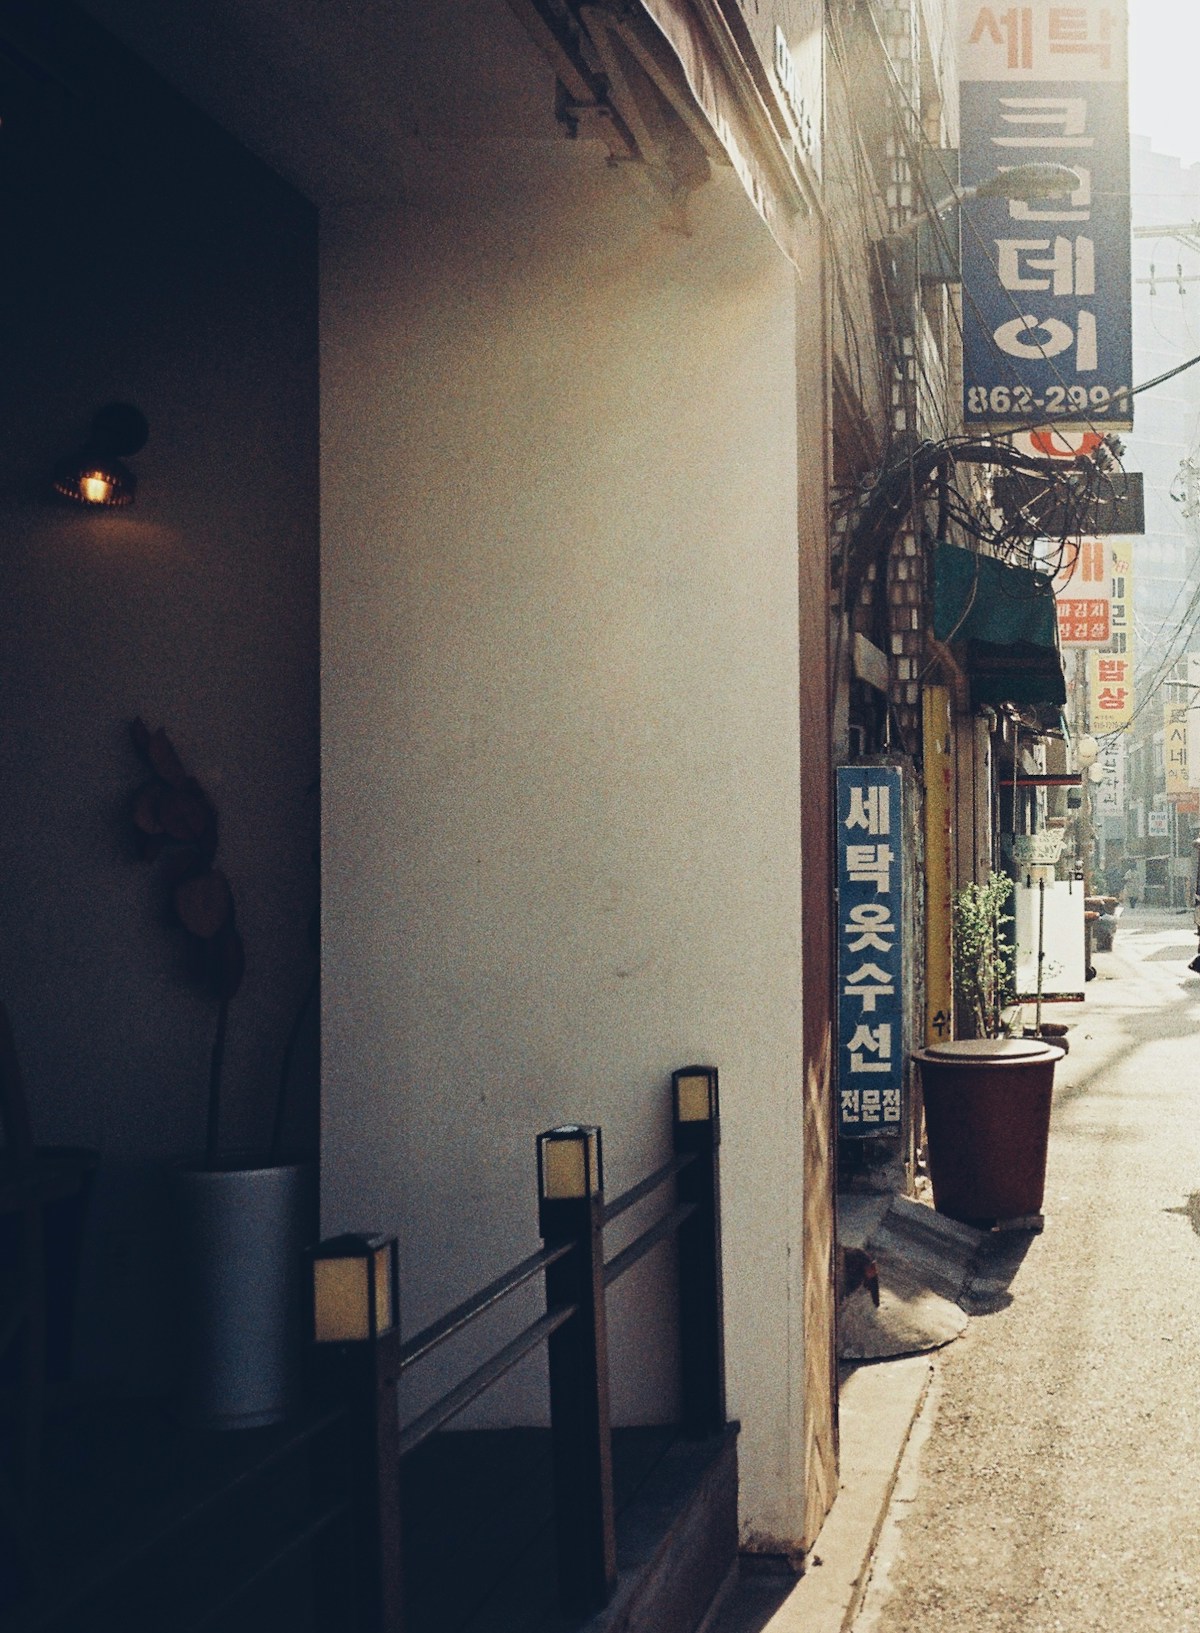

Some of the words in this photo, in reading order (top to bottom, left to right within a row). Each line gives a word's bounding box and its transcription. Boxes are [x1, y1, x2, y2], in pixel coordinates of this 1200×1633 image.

[967, 6, 1119, 70] 세탁
[967, 385, 1130, 414] 862-2991
[1097, 659, 1129, 710] 밥상
[843, 785, 896, 1073] 세탁옷수선
[840, 1088, 901, 1123] 전문점
